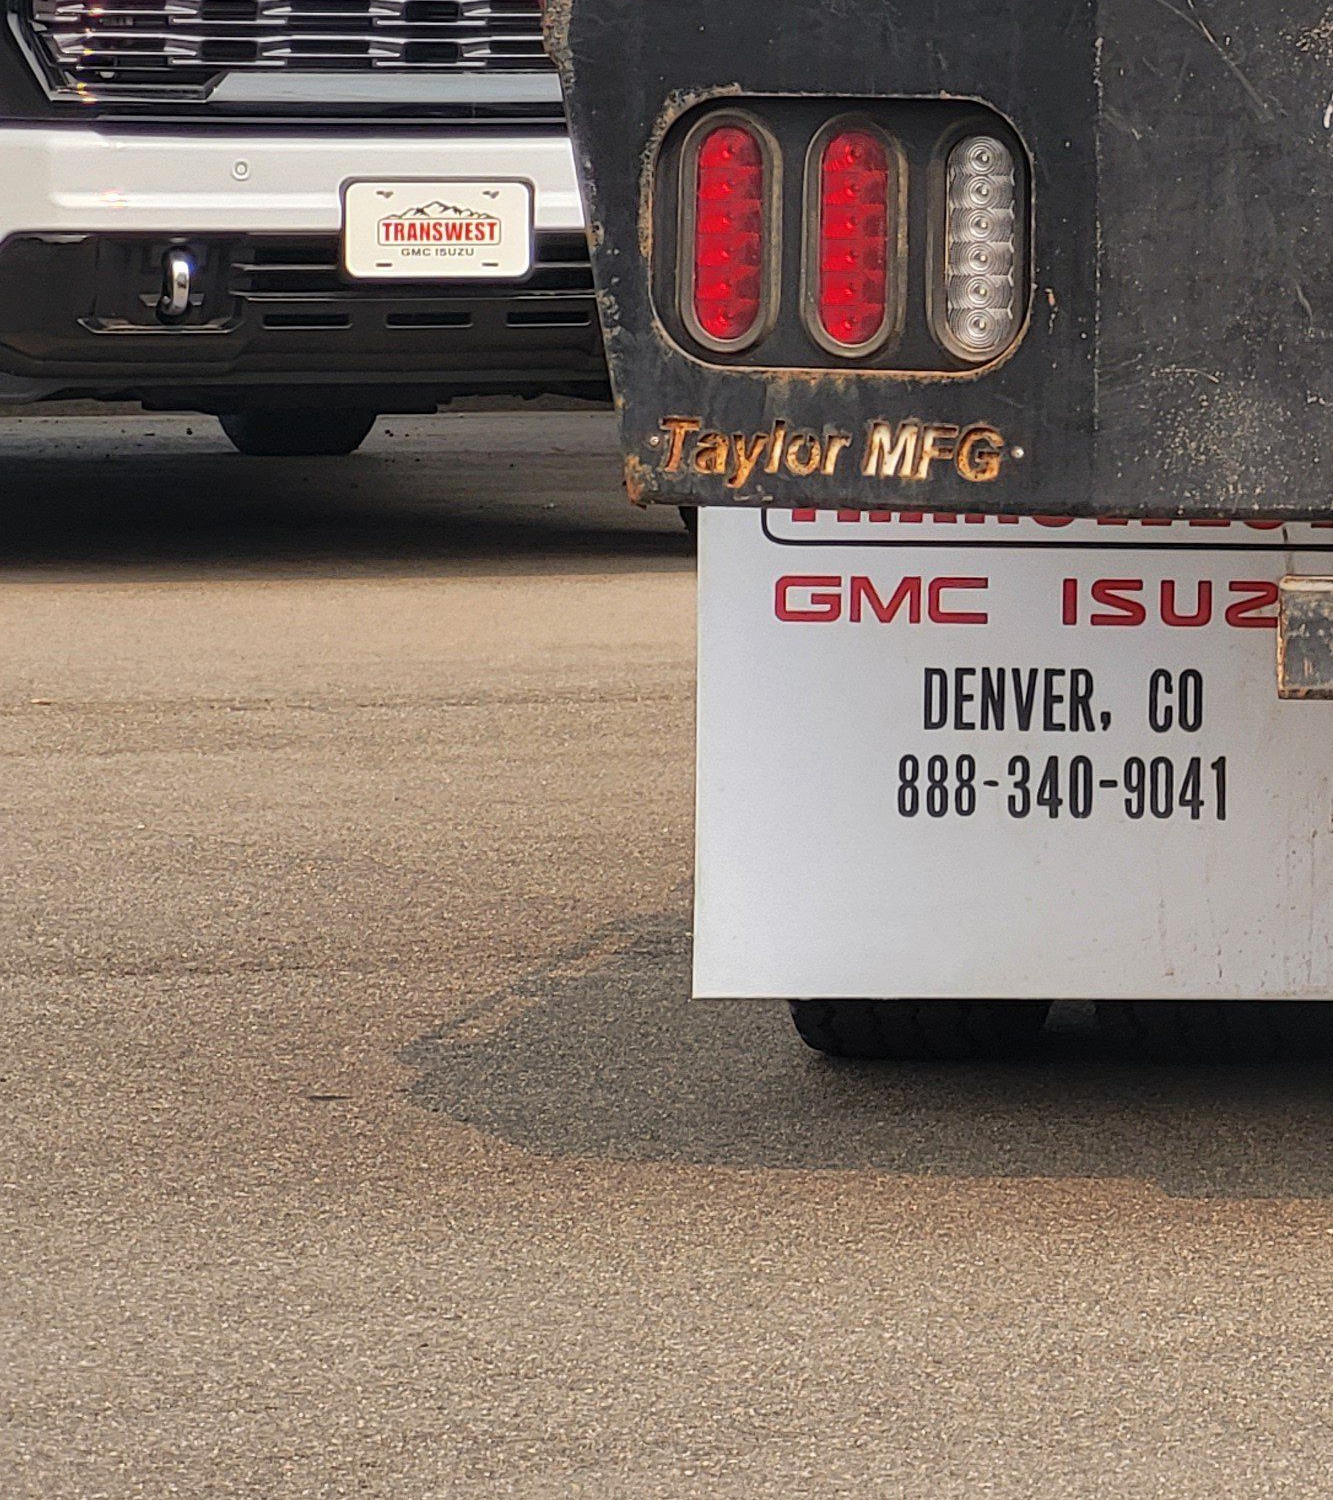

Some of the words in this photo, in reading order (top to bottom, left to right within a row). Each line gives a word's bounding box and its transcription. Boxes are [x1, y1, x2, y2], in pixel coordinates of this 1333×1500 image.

[382, 222, 498, 241] TRANSWEST
[401, 248, 431, 257] GMC
[435, 248, 475, 257] ISUZU
[660, 416, 850, 489] Taylor
[861, 418, 1005, 483] MFG
[774, 575, 989, 624] GMC
[1061, 577, 1279, 629] ISUZ
[923, 666, 1112, 733] DENVER,
[1148, 667, 1204, 734] CO
[897, 753, 1227, 821] 888-340-9041
